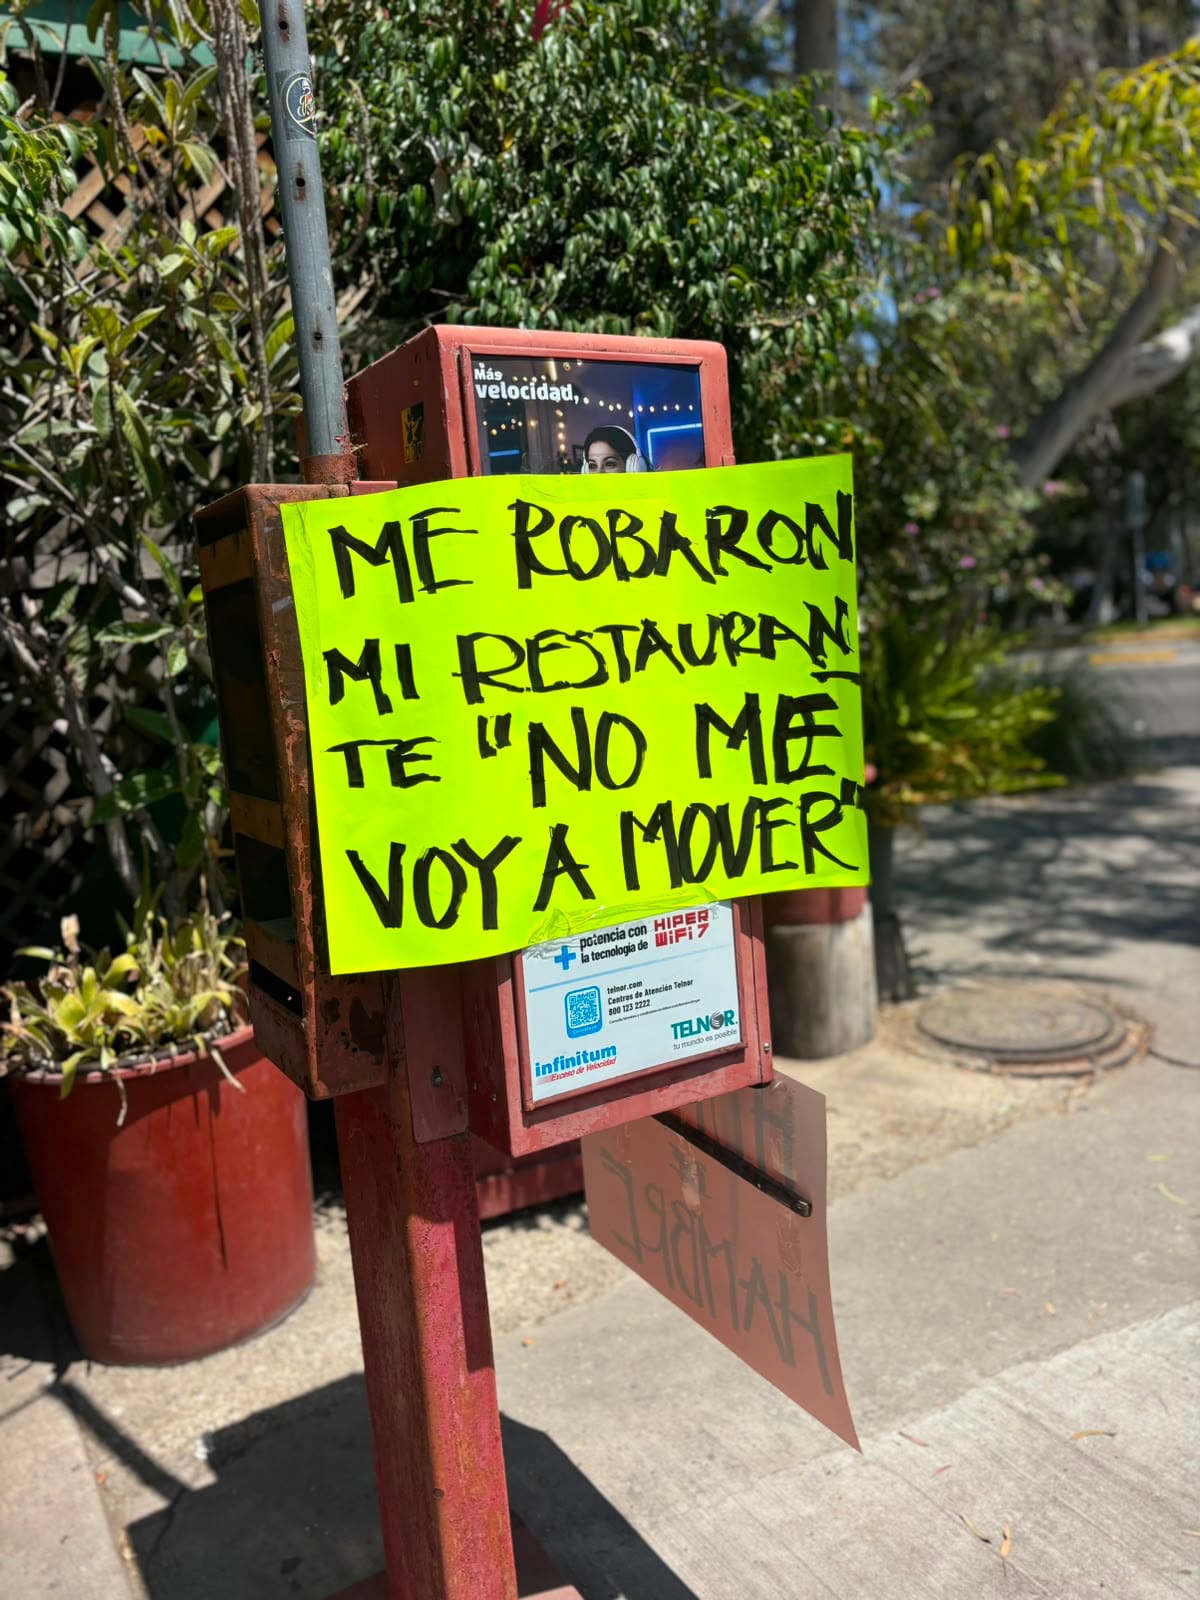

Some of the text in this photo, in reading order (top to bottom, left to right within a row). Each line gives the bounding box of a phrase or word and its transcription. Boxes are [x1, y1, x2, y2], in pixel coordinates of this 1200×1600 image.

[474, 362, 502, 381] Más
[475, 381, 579, 405] velocidad,
[327, 489, 854, 604] ME ROBARON
[322, 637, 420, 716] MI
[325, 736, 442, 789] TE
[693, 692, 844, 785] ME
[344, 835, 523, 931] VOY
[532, 822, 596, 913] A
[654, 909, 709, 931] HIPER
[697, 922, 710, 939] 7
[580, 924, 648, 953] potencia con
[581, 952, 590, 964] la
[638, 939, 649, 951] de
[606, 980, 643, 995] telnor.com
[607, 979, 694, 1005] Centros de Atención Telnor
[608, 999, 651, 1016] 800 123 2222
[681, 1036, 705, 1048] mundo
[714, 1028, 737, 1041] posible
[535, 1045, 617, 1077] infinitum
[575, 1067, 584, 1075] de
[586, 1057, 617, 1072] Velocidad
